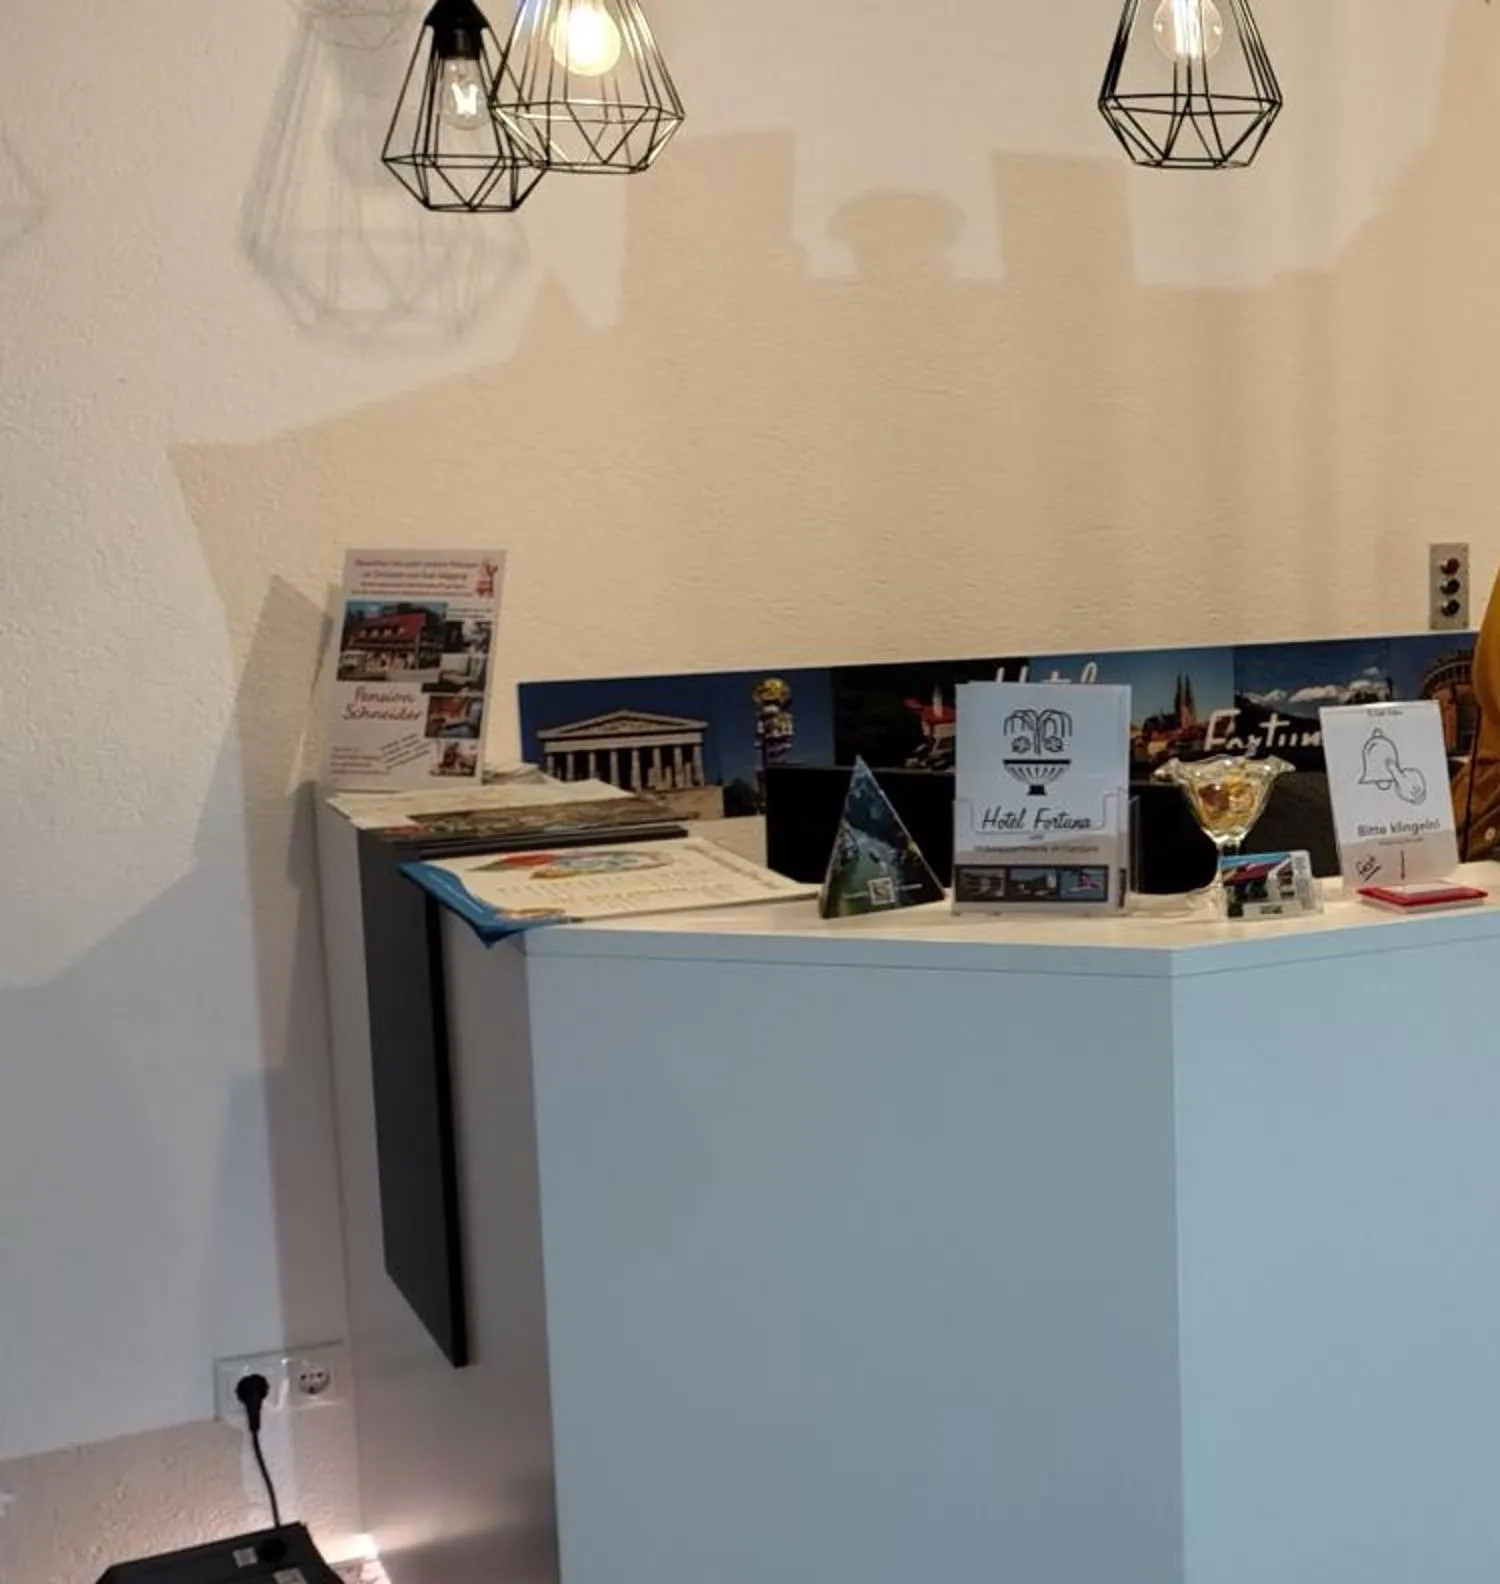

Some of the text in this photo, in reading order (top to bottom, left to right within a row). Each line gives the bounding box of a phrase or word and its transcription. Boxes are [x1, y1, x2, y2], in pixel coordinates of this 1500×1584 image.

[354, 684, 415, 703] Pension
[342, 702, 422, 721] Schneider
[981, 805, 1093, 831] Hotel Fortuna
[1357, 823, 1387, 837] Bitte
